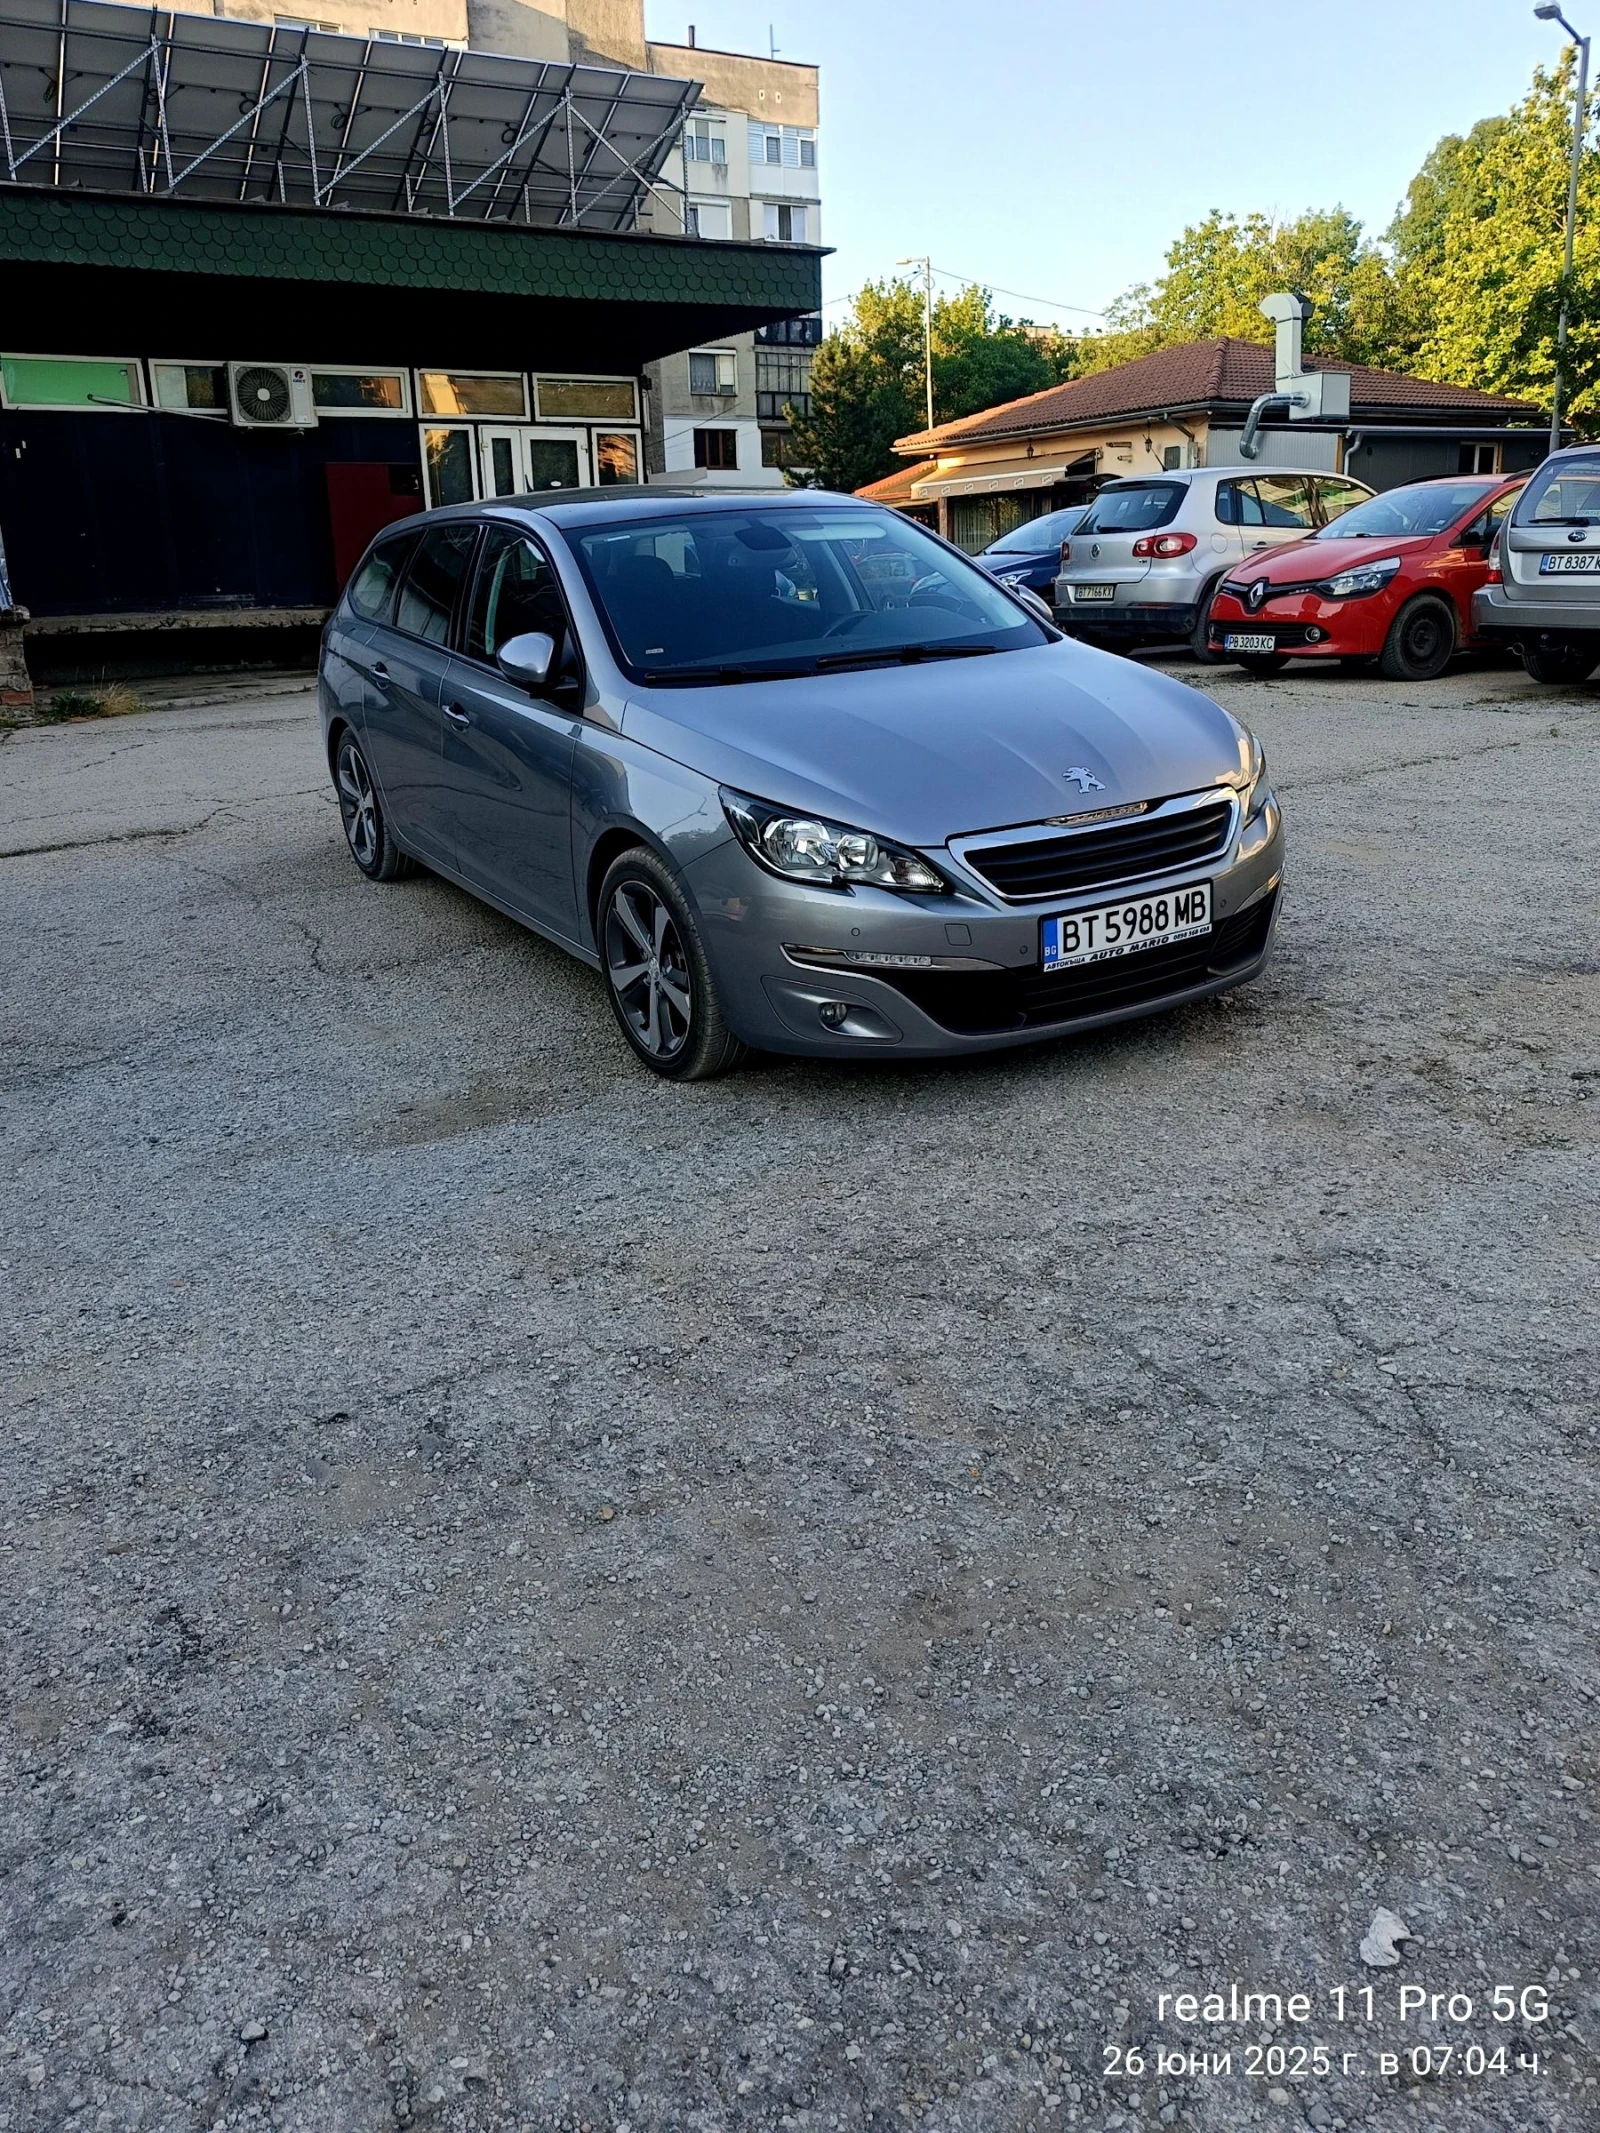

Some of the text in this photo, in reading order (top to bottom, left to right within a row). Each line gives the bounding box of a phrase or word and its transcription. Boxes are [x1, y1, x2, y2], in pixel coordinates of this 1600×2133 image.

[1565, 555, 1594, 569] 8387
[1239, 636, 1260, 648] 3203
[1063, 890, 1206, 954] BT 5988 MB
[1044, 945, 1057, 957] BG
[1089, 947, 1125, 962] AUTO
[1129, 936, 1170, 952] MARIO
